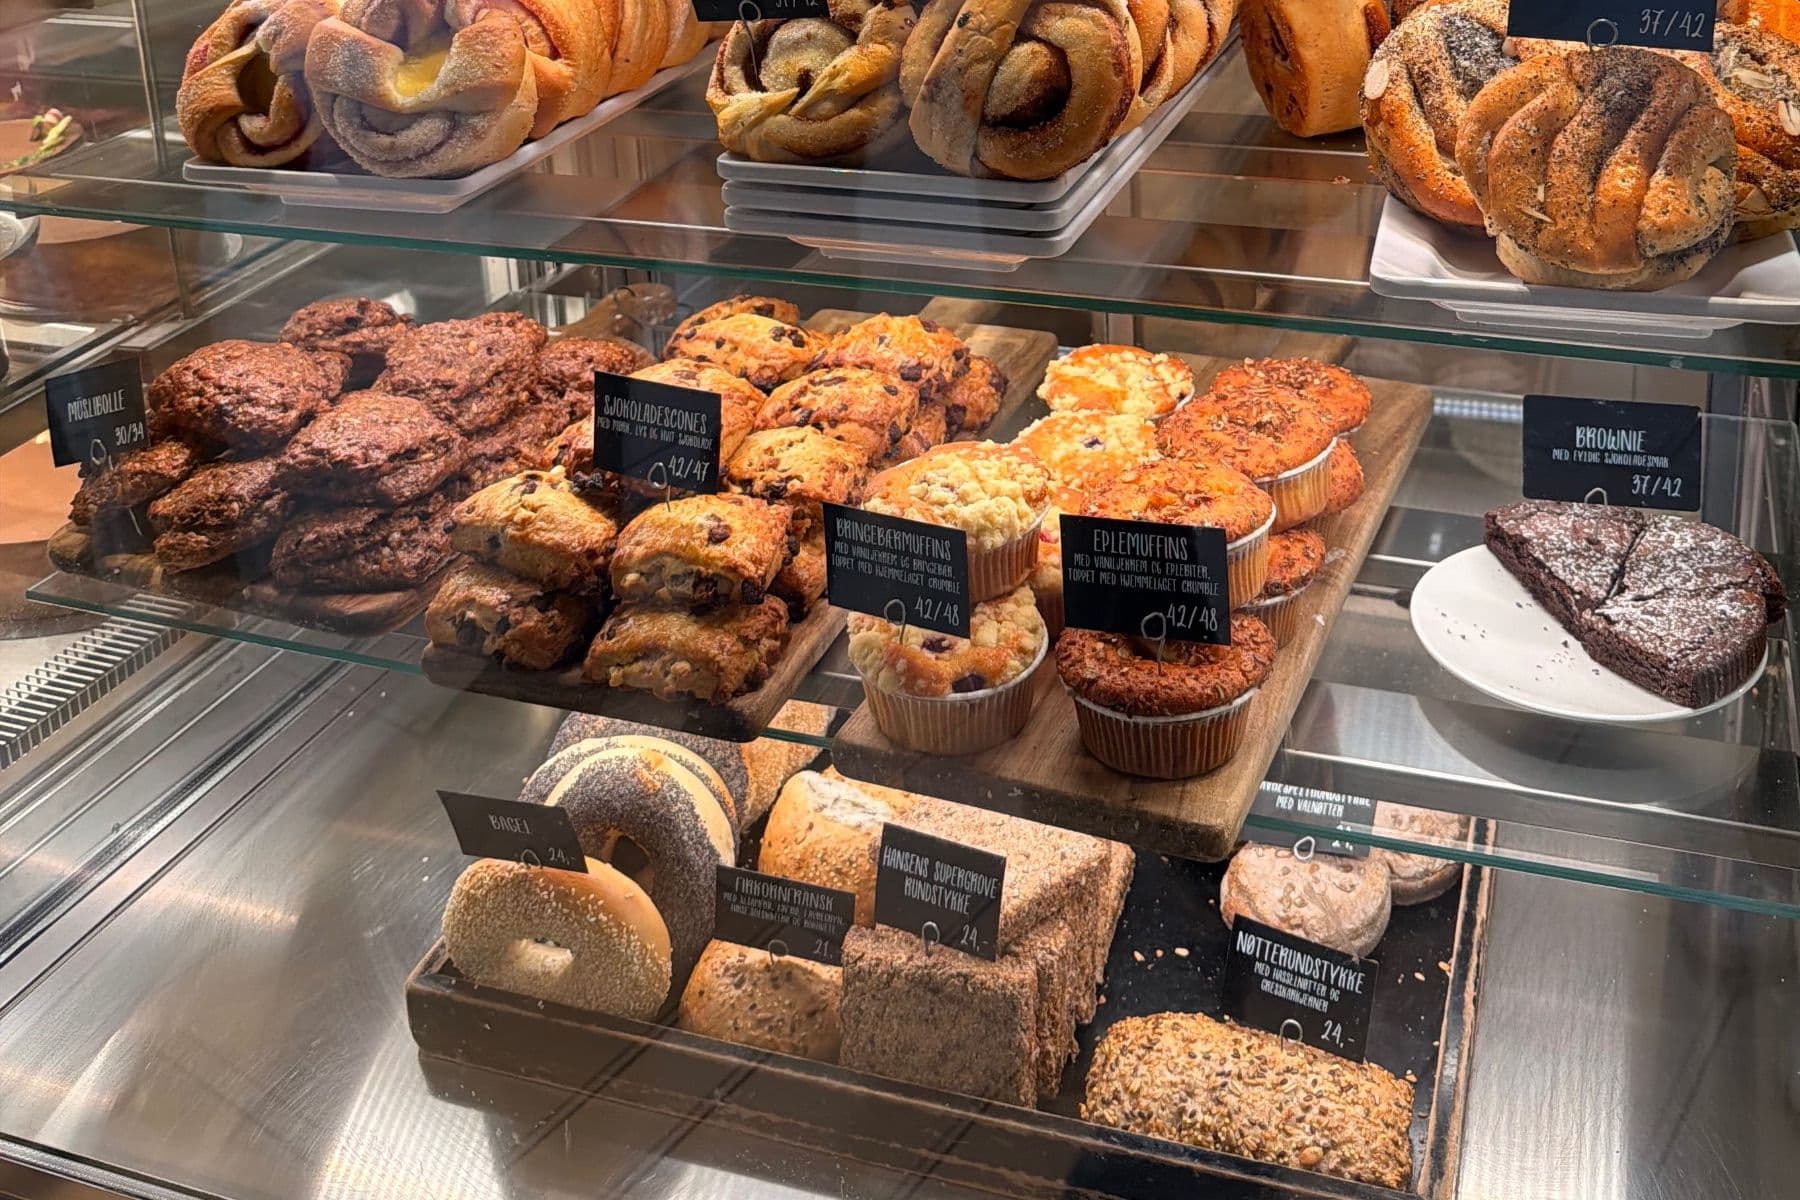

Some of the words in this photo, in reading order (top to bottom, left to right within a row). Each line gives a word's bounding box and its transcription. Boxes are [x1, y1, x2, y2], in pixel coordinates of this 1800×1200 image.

[1639, 8, 1706, 39] 37/42
[603, 394, 708, 435] SJOKOLADESCONES
[114, 421, 145, 447] 30/34
[1575, 425, 1648, 453] BROWNIE
[1552, 447, 1570, 461] MED
[668, 455, 710, 483] 42/47
[1631, 473, 1682, 498] 37/42
[834, 540, 849, 555] MED
[835, 516, 951, 561] BRINGEBÆRMUFFINS
[1093, 528, 1189, 561] EPLEMUFFINS
[831, 553, 855, 570] TOPPET
[857, 560, 873, 575] MED
[1073, 552, 1091, 568] MED
[1151, 561, 1162, 575] OG
[1067, 567, 1095, 583] TOPPET
[1100, 571, 1117, 586] MED
[1120, 573, 1177, 593] HJEMMELAGET
[1181, 579, 1220, 596] CRUMBLE
[914, 596, 960, 627] 42/48
[1167, 603, 1218, 632] 42/48
[1275, 794, 1295, 810] MED
[1297, 798, 1345, 818] VALNØTTER
[488, 813, 533, 835] BAGEL
[882, 845, 930, 878] HANSENS
[933, 860, 999, 899] SUPERGROVE
[904, 875, 972, 915] RUNDSTYKKE
[1236, 930, 1366, 995] NØTTERUNDSTYKKE
[1254, 961, 1271, 977] MED
[1272, 966, 1328, 998] HASSELNØTTER
[1329, 988, 1341, 1003] OG
